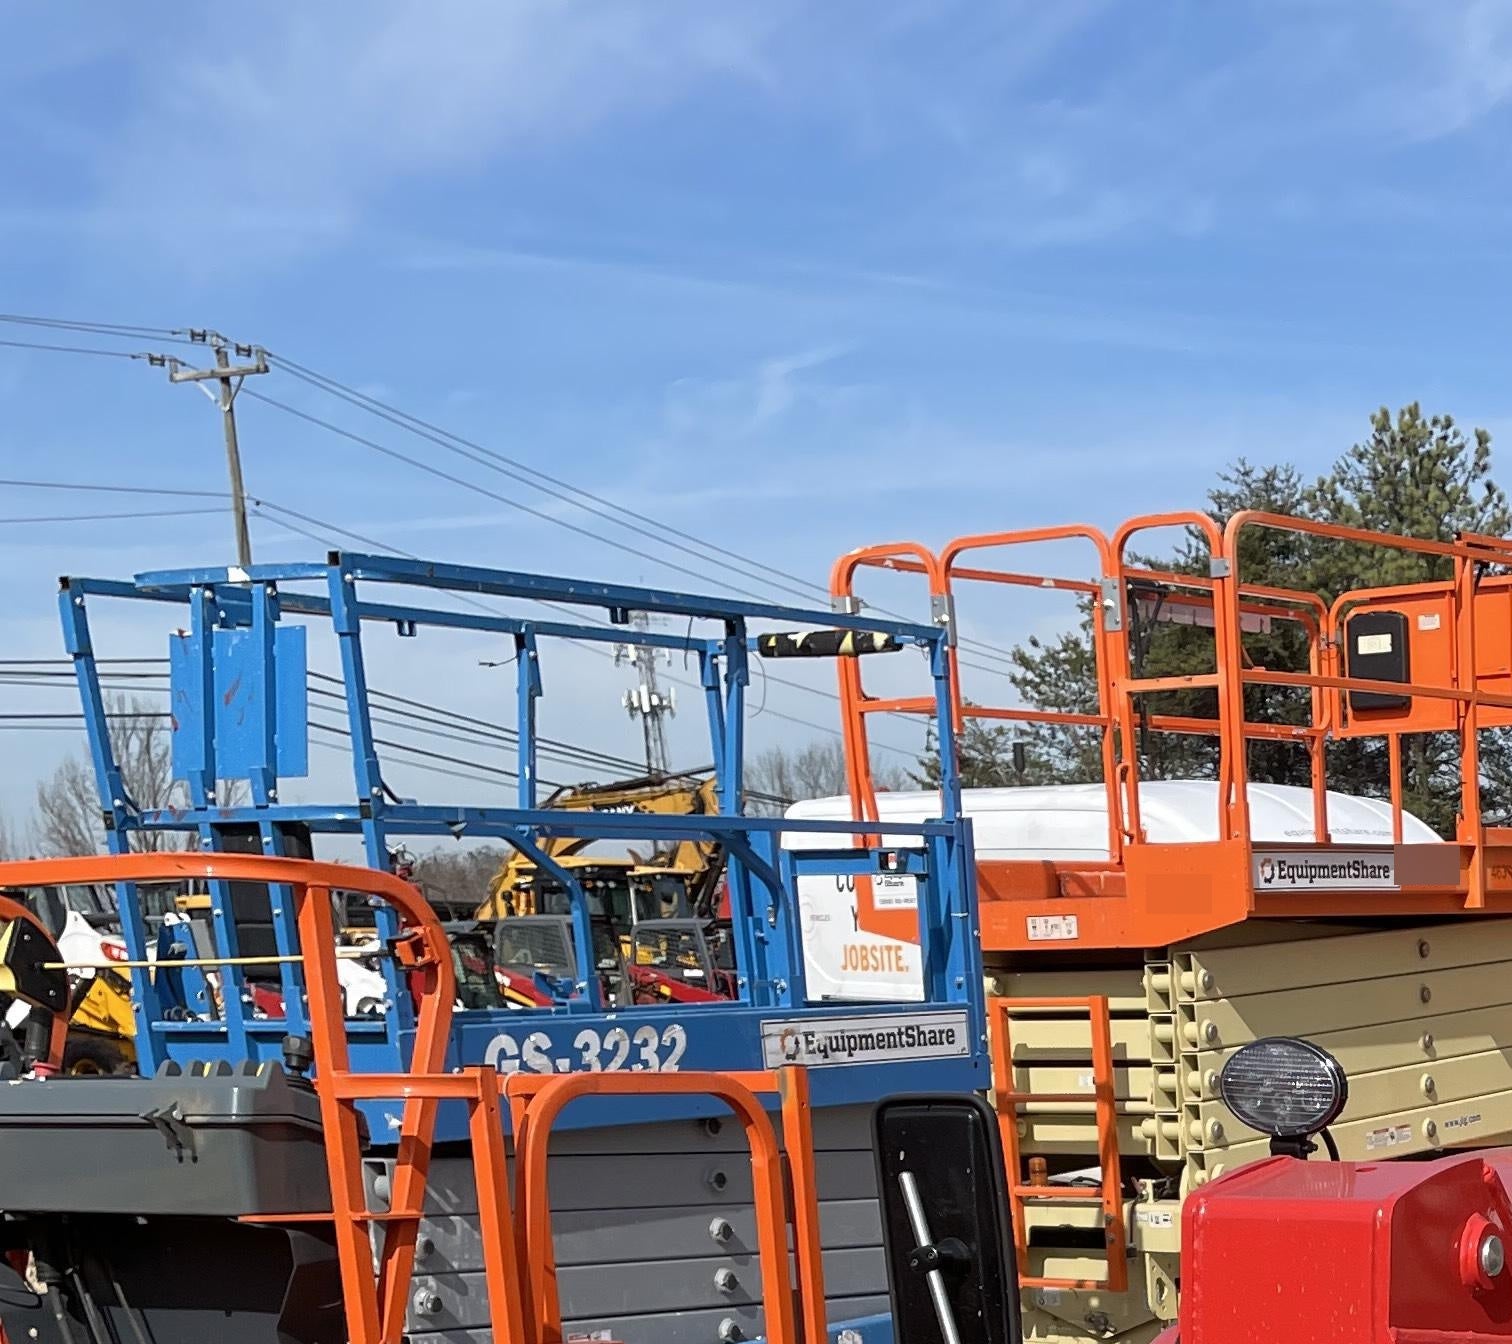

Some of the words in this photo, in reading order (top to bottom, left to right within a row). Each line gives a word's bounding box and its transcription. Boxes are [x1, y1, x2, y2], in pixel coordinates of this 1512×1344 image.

[1277, 858, 1391, 884] EquipmentShare
[841, 944, 909, 973] JOBSITE.
[484, 1024, 687, 1074] GS-3232
[802, 1025, 956, 1059] EquipmentShare
